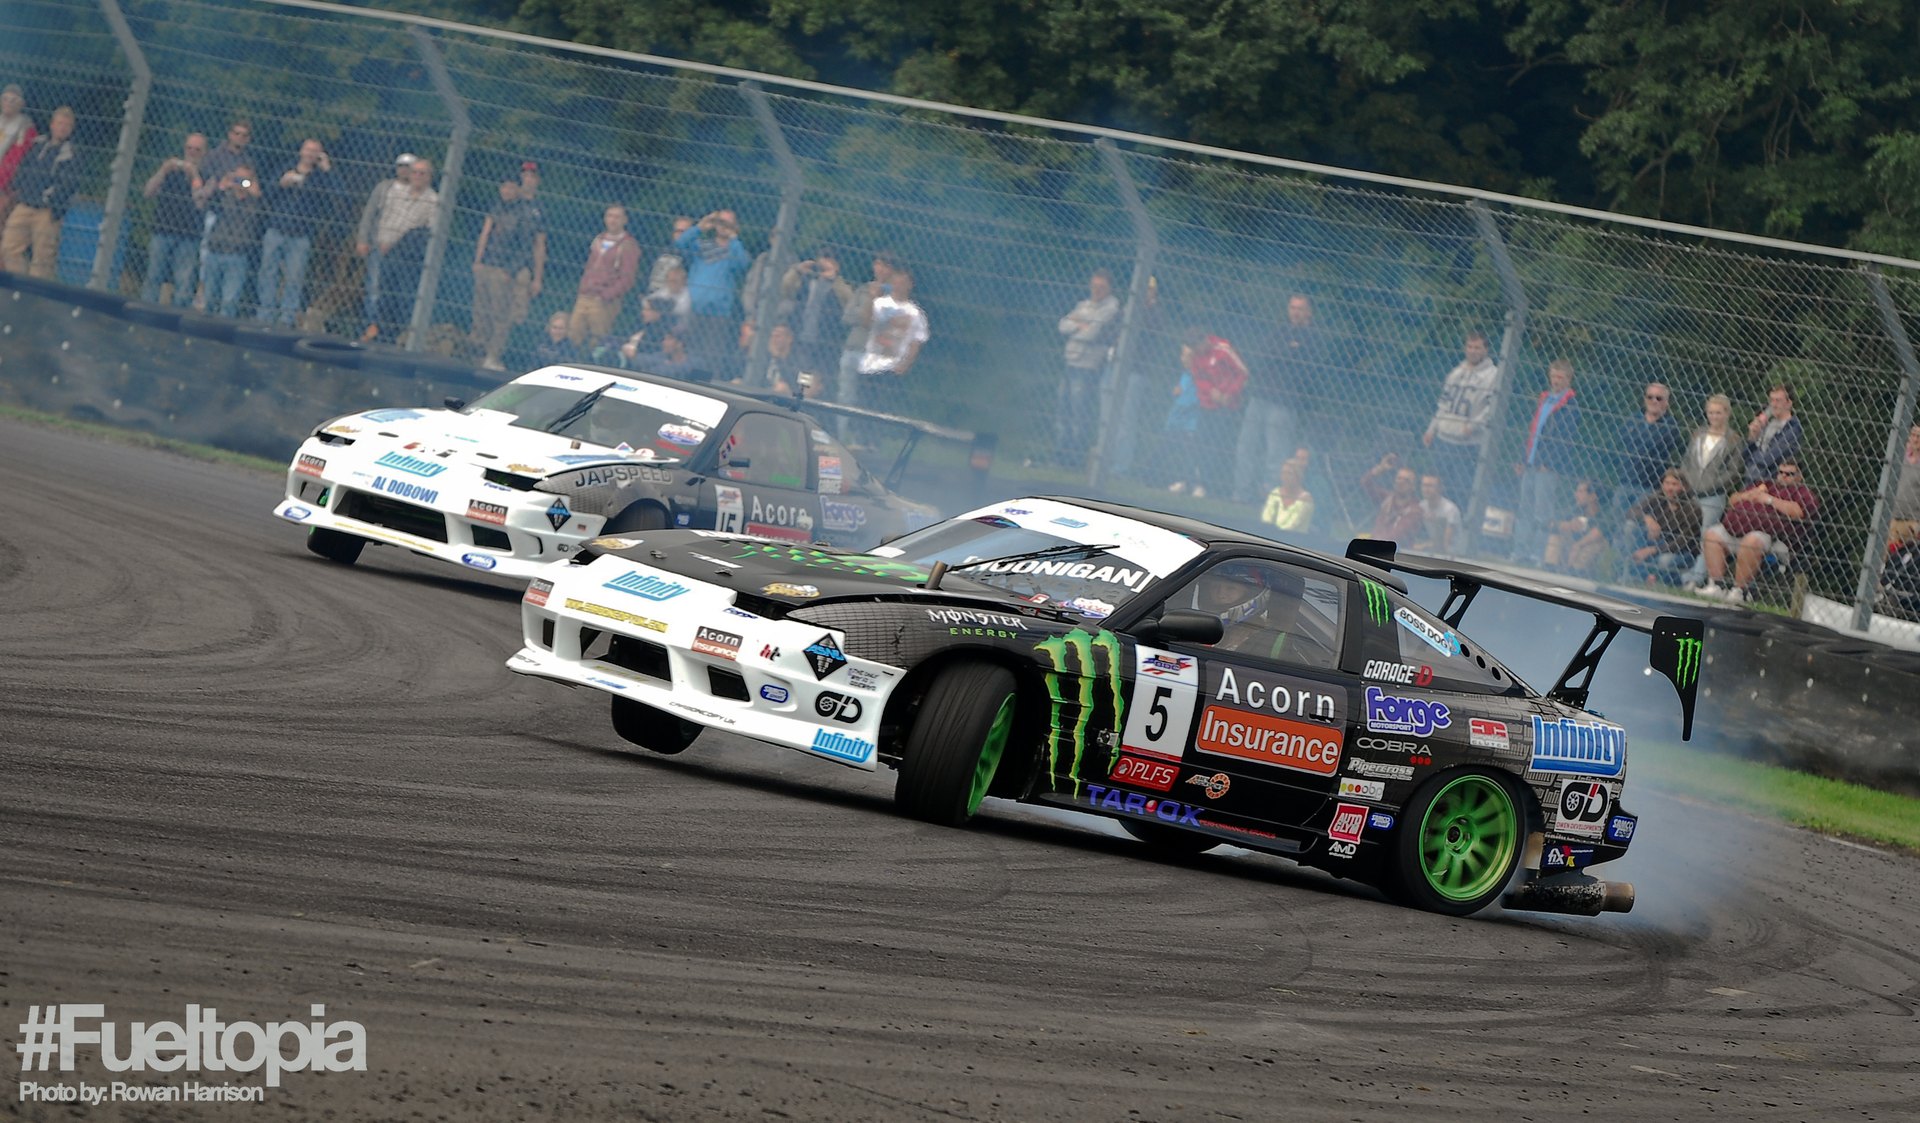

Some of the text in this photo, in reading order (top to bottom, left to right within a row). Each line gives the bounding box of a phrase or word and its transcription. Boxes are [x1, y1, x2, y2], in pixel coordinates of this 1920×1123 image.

[374, 451, 448, 478] Infinity
[576, 466, 673, 487] JAPSPEED
[372, 476, 438, 504] AL DOBOWI
[471, 501, 506, 515] Acorn
[601, 570, 691, 601] Infinity
[1400, 610, 1425, 633] BOSS
[699, 628, 739, 647] Acorn
[950, 628, 1017, 639] ENERGY
[1216, 667, 1336, 718] Acorn
[1145, 686, 1173, 742] 5
[1365, 686, 1452, 737] Forge
[1371, 721, 1413, 731] MOTORSPORT
[811, 728, 875, 763] Infinity
[1202, 710, 1339, 766] Insurance
[1357, 738, 1433, 756] COBRA
[1471, 740, 1509, 749] CLUTCH
[1531, 715, 1624, 777] Infinity
[1130, 762, 1175, 784] PLFS
[1347, 757, 1415, 776] Pipercross
